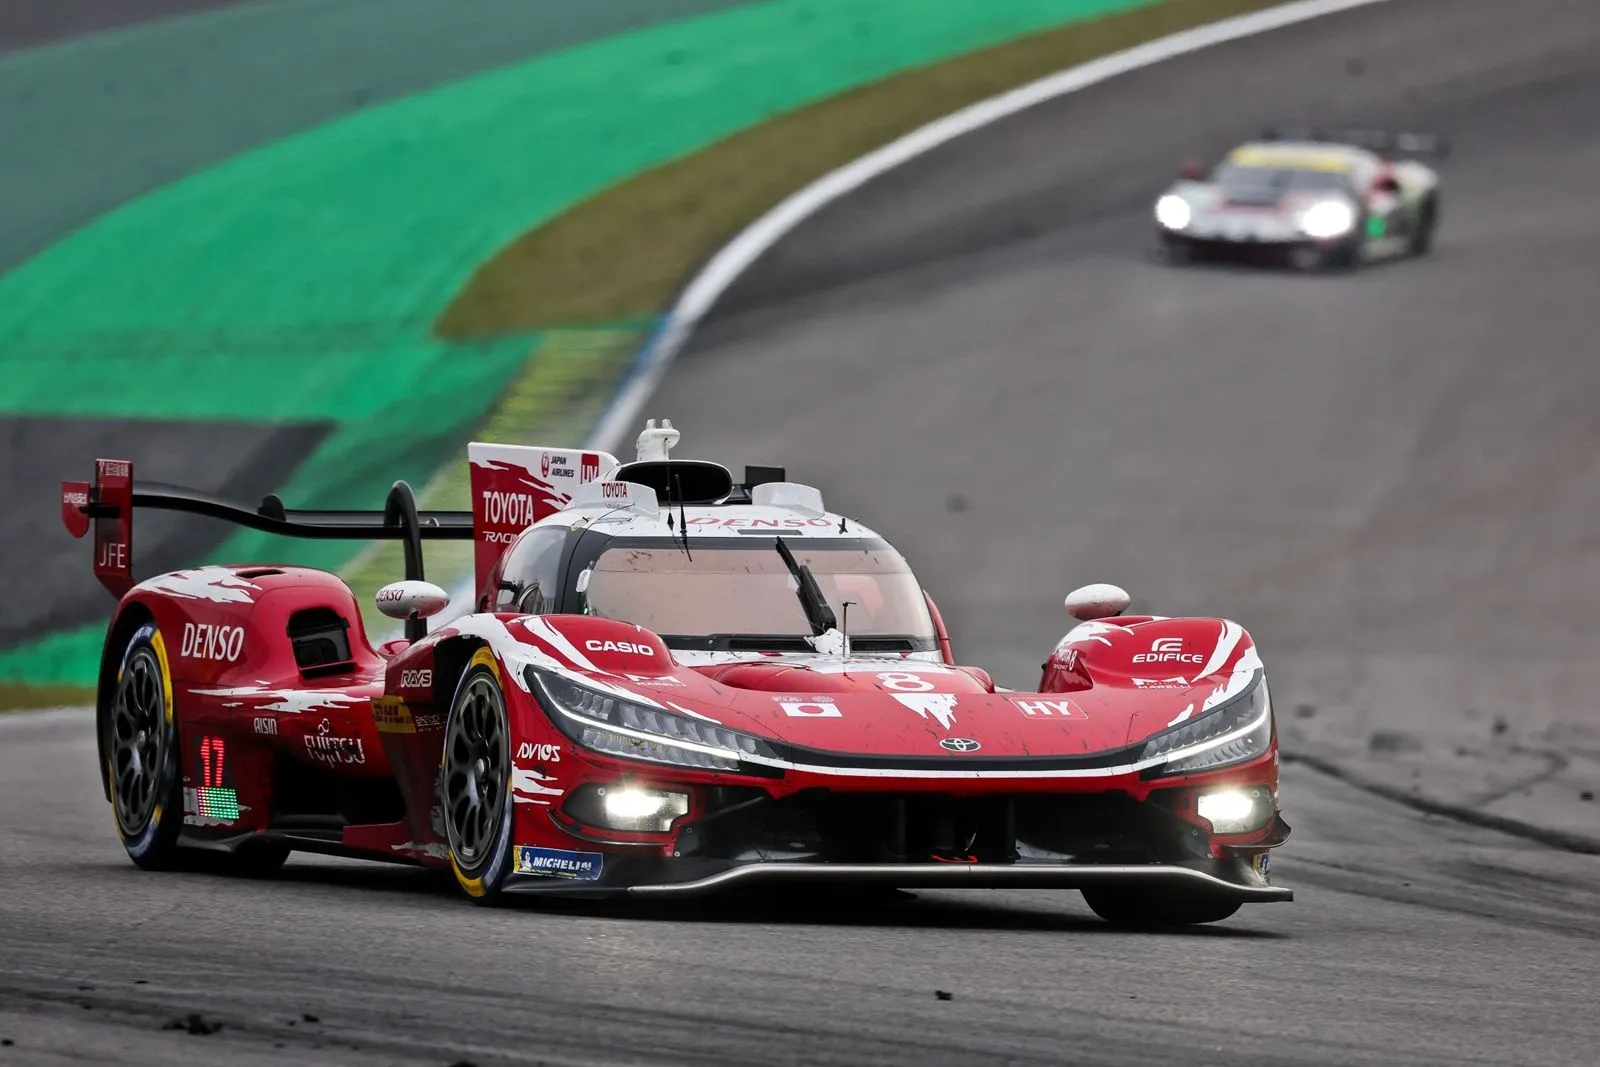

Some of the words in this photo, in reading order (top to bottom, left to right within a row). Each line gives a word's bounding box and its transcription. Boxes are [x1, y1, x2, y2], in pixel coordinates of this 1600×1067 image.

[551, 456, 567, 465] JAPAN
[552, 468, 575, 478] AIRLINES
[602, 483, 628, 498] TOYOTA
[483, 491, 534, 526] TOYOTA
[687, 518, 832, 527] DENSO
[99, 543, 126, 568] JFE
[181, 623, 245, 662] DENSO
[585, 639, 654, 656] CASIO
[1132, 653, 1203, 663] EDIFICE
[401, 669, 432, 688] RAYS
[875, 671, 935, 692] 8
[1017, 700, 1072, 715] HY
[253, 717, 277, 735] AISIN
